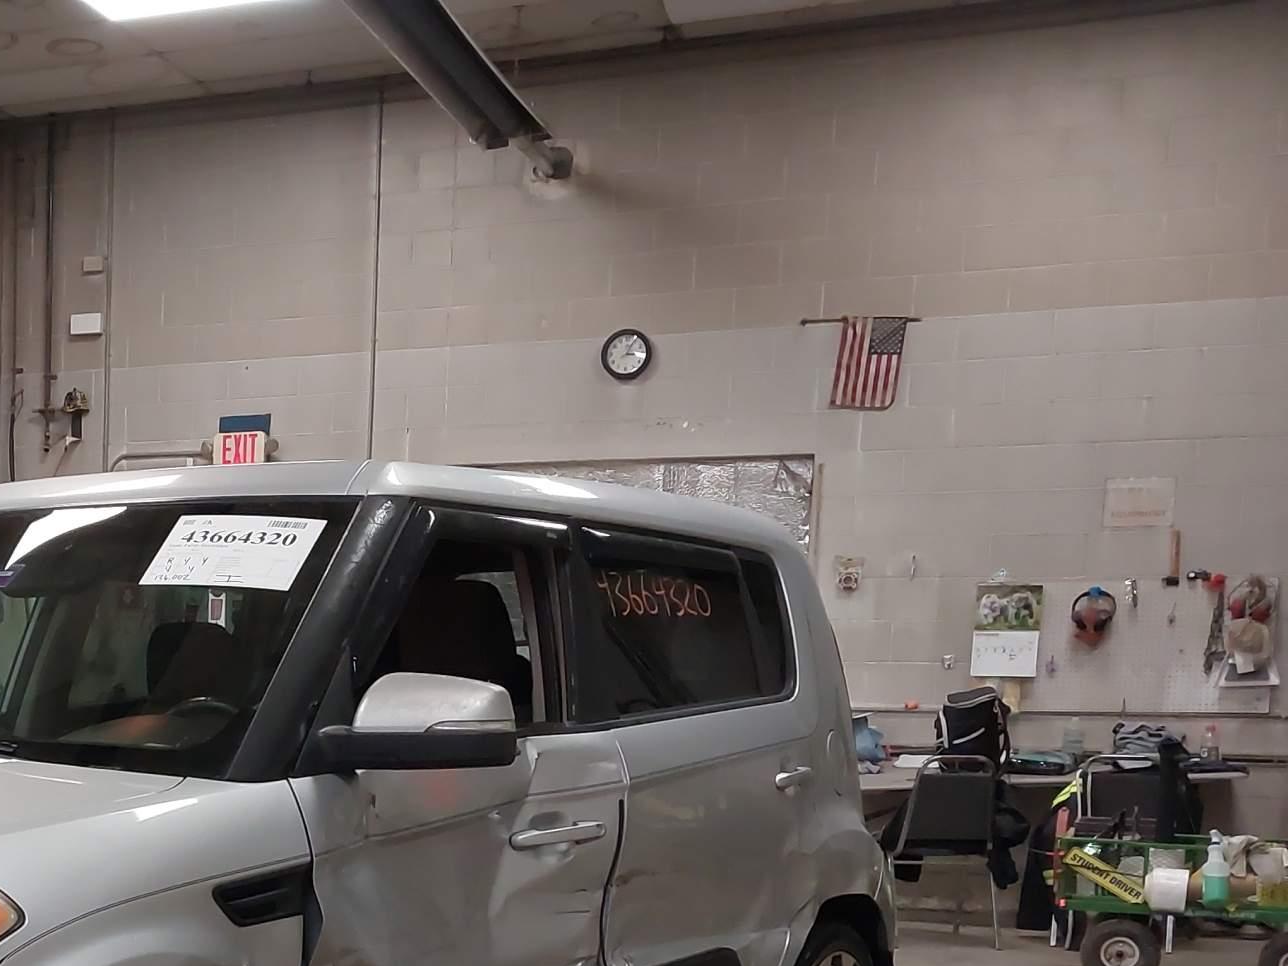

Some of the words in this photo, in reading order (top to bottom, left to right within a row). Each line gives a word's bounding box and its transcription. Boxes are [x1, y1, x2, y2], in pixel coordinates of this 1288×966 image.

[222, 433, 258, 464] EXIT
[181, 530, 297, 546] 43664320
[597, 569, 711, 616] 43664320
[1069, 852, 1111, 883] STUDENT
[1108, 876, 1142, 901] DRIVER
